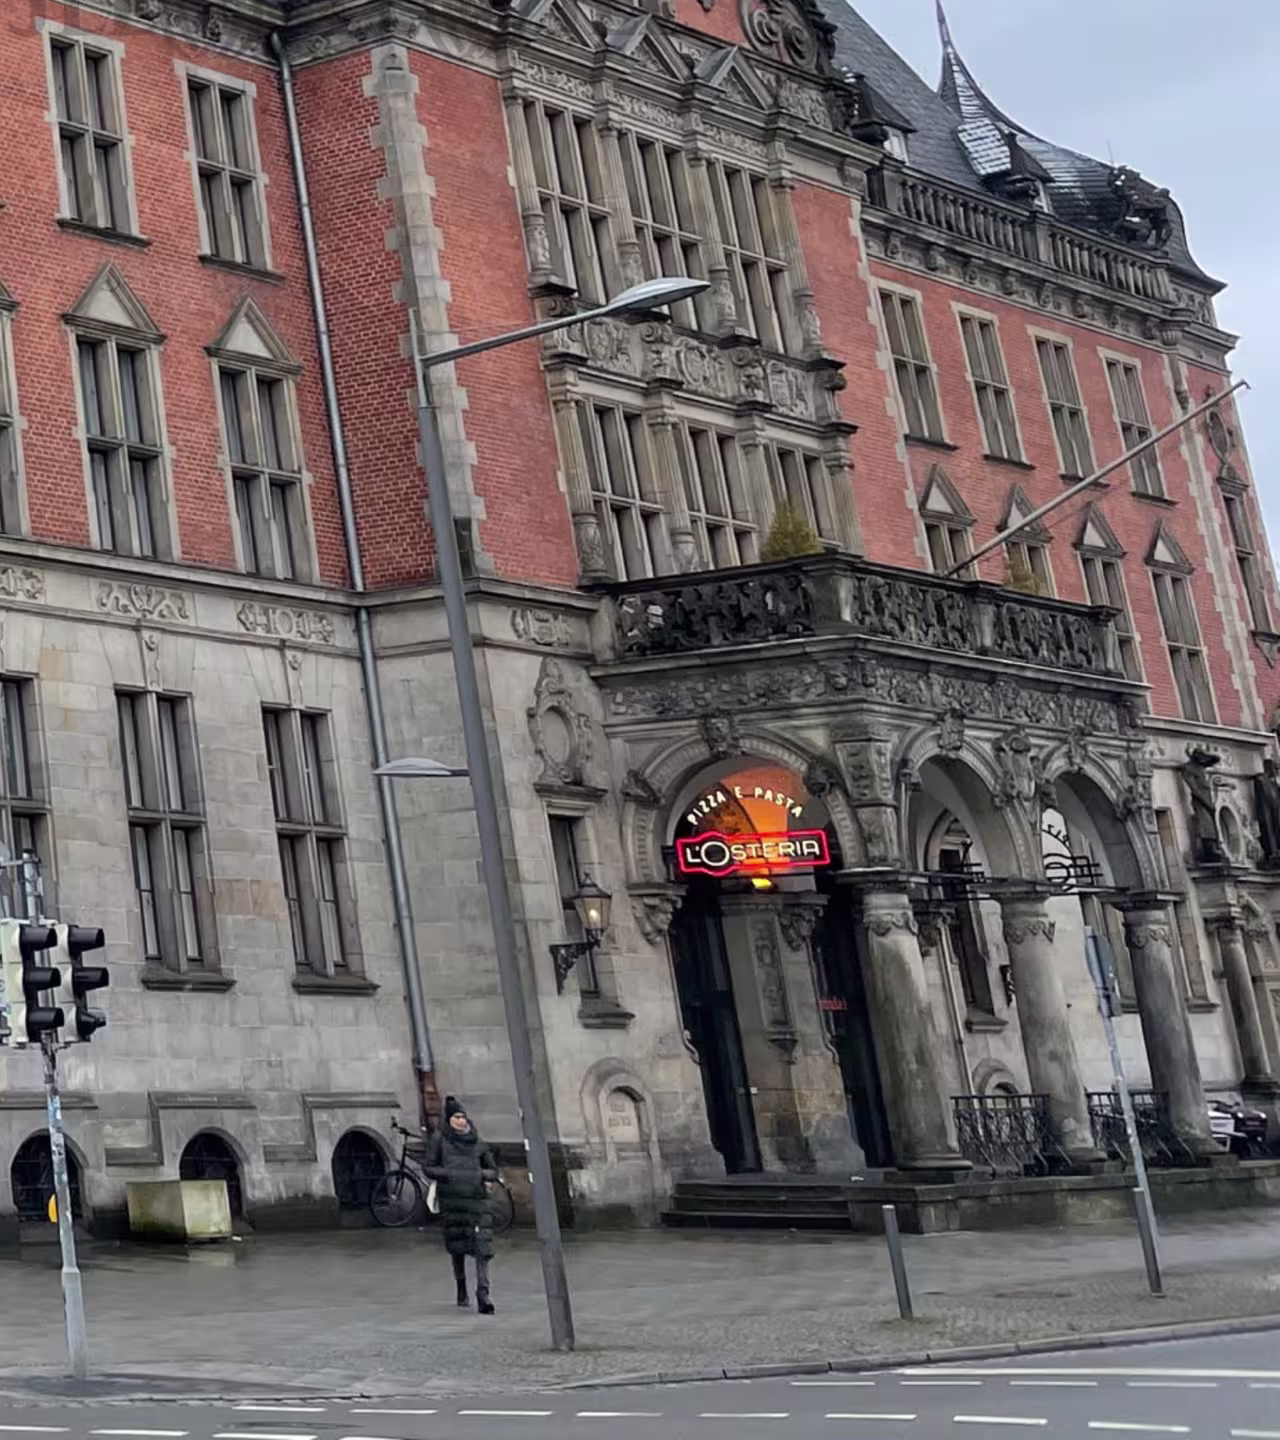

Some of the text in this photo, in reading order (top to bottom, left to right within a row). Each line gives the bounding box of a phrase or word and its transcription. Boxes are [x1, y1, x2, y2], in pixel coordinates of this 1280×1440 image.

[686, 786, 804, 826] PIZZA E PASTA
[685, 840, 820, 867] L'OSTERIA
